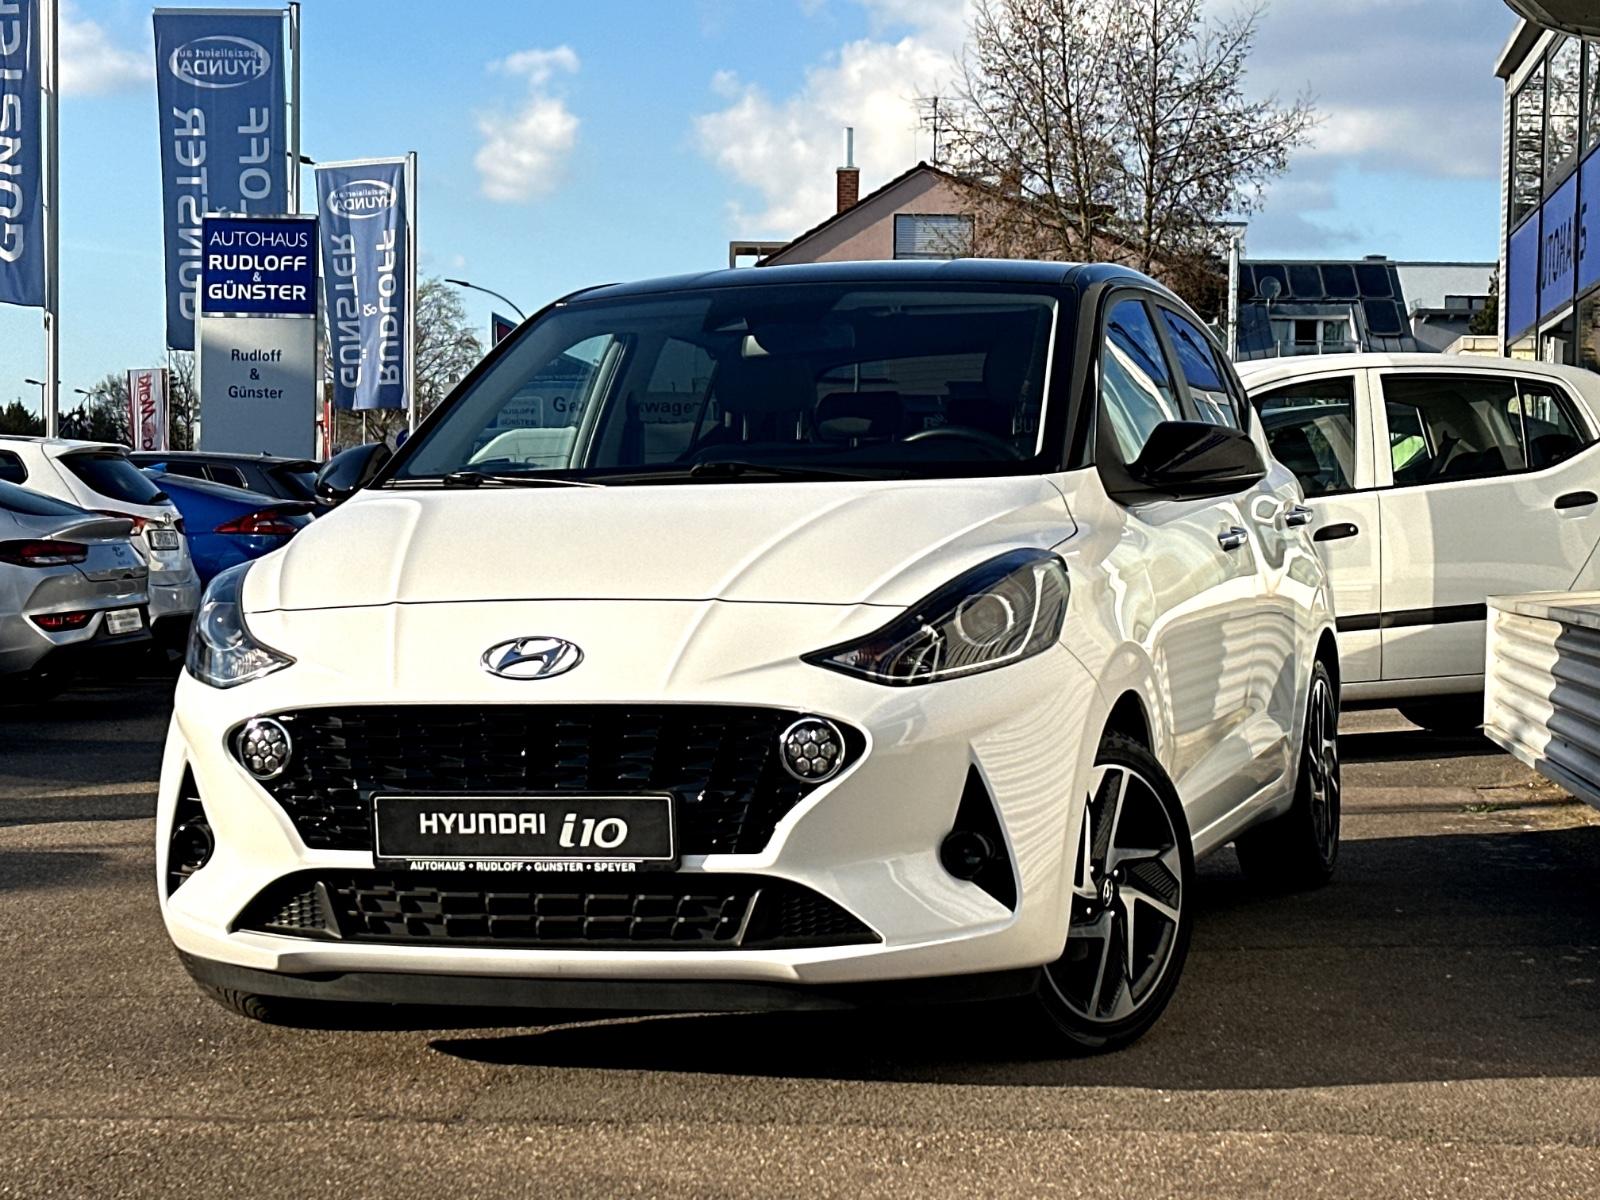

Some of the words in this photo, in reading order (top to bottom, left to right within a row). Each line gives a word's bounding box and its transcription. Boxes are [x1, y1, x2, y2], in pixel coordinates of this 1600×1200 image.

[209, 231, 308, 248] AUTOHAUS
[208, 254, 307, 272] RUDLOFF
[252, 271, 262, 282] &
[208, 280, 307, 301] GÜNSTER
[231, 348, 283, 362] Rudloff
[249, 368, 260, 380] &
[228, 385, 284, 399] Günster
[419, 812, 546, 835] HYUNDAI
[558, 812, 629, 849] i10
[410, 861, 466, 871] AUTOHAUS
[476, 861, 523, 872] RUDLOFF
[594, 862, 636, 872] SPEYER
